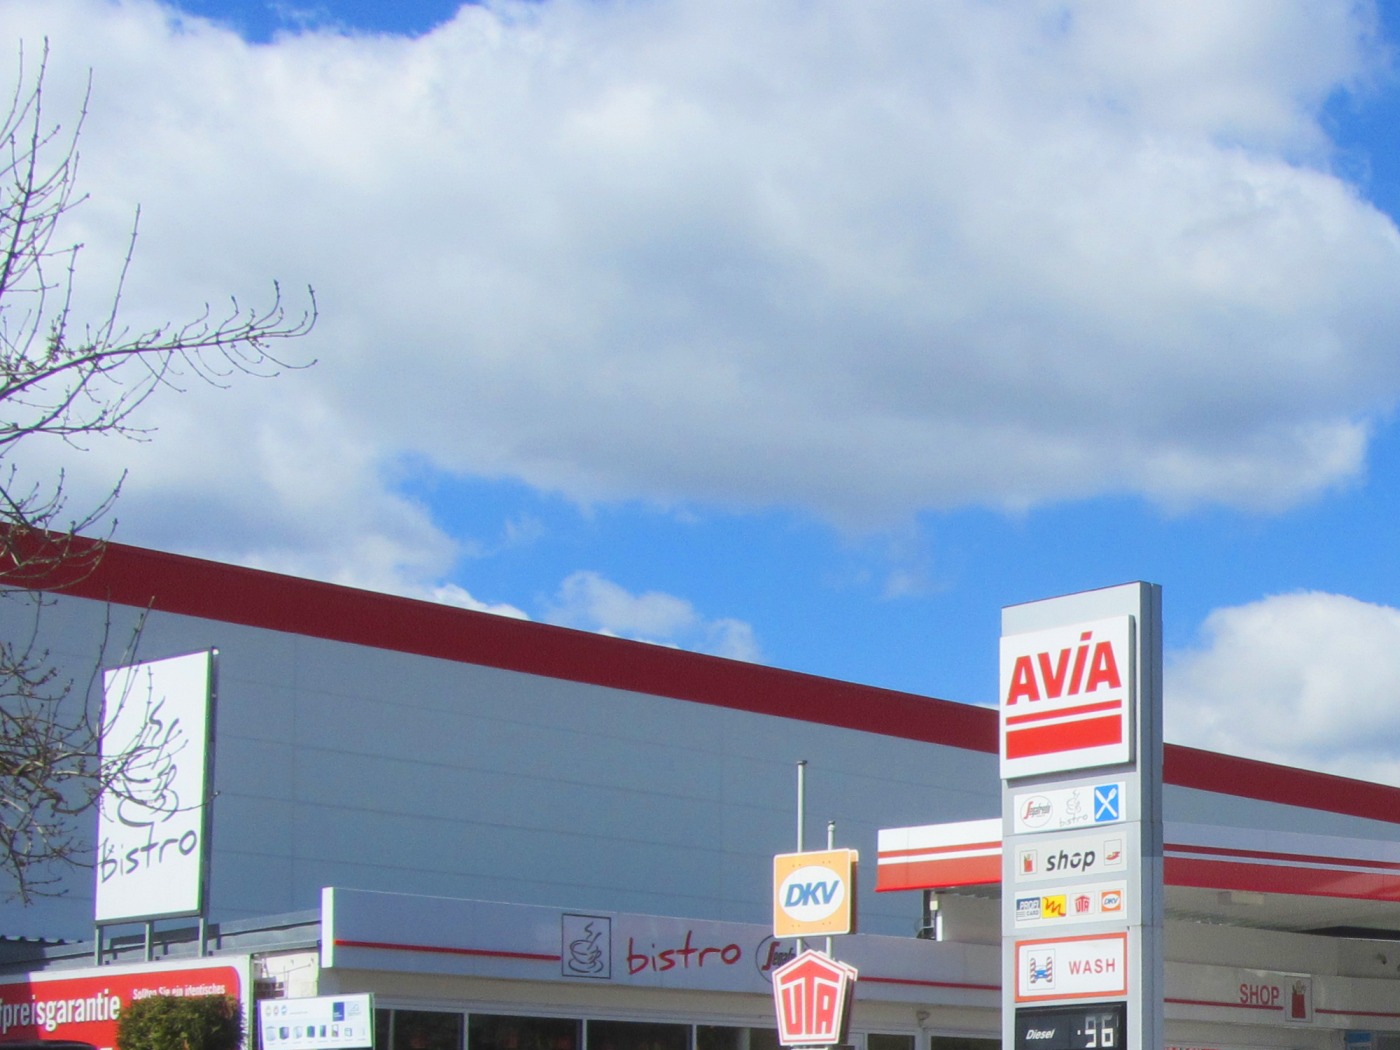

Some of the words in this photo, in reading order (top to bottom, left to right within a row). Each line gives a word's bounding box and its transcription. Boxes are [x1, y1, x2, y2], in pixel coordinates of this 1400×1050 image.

[99, 822, 198, 883] bistro
[1045, 850, 1096, 872] shop
[784, 880, 840, 908] DKV
[626, 930, 742, 976] bistro
[1068, 958, 1116, 975] WASH
[780, 960, 841, 1035] UTA
[1239, 983, 1280, 1005] SHOP
[0, 988, 121, 1035] preisgarantie
[1025, 1028, 1056, 1040] Diesel
